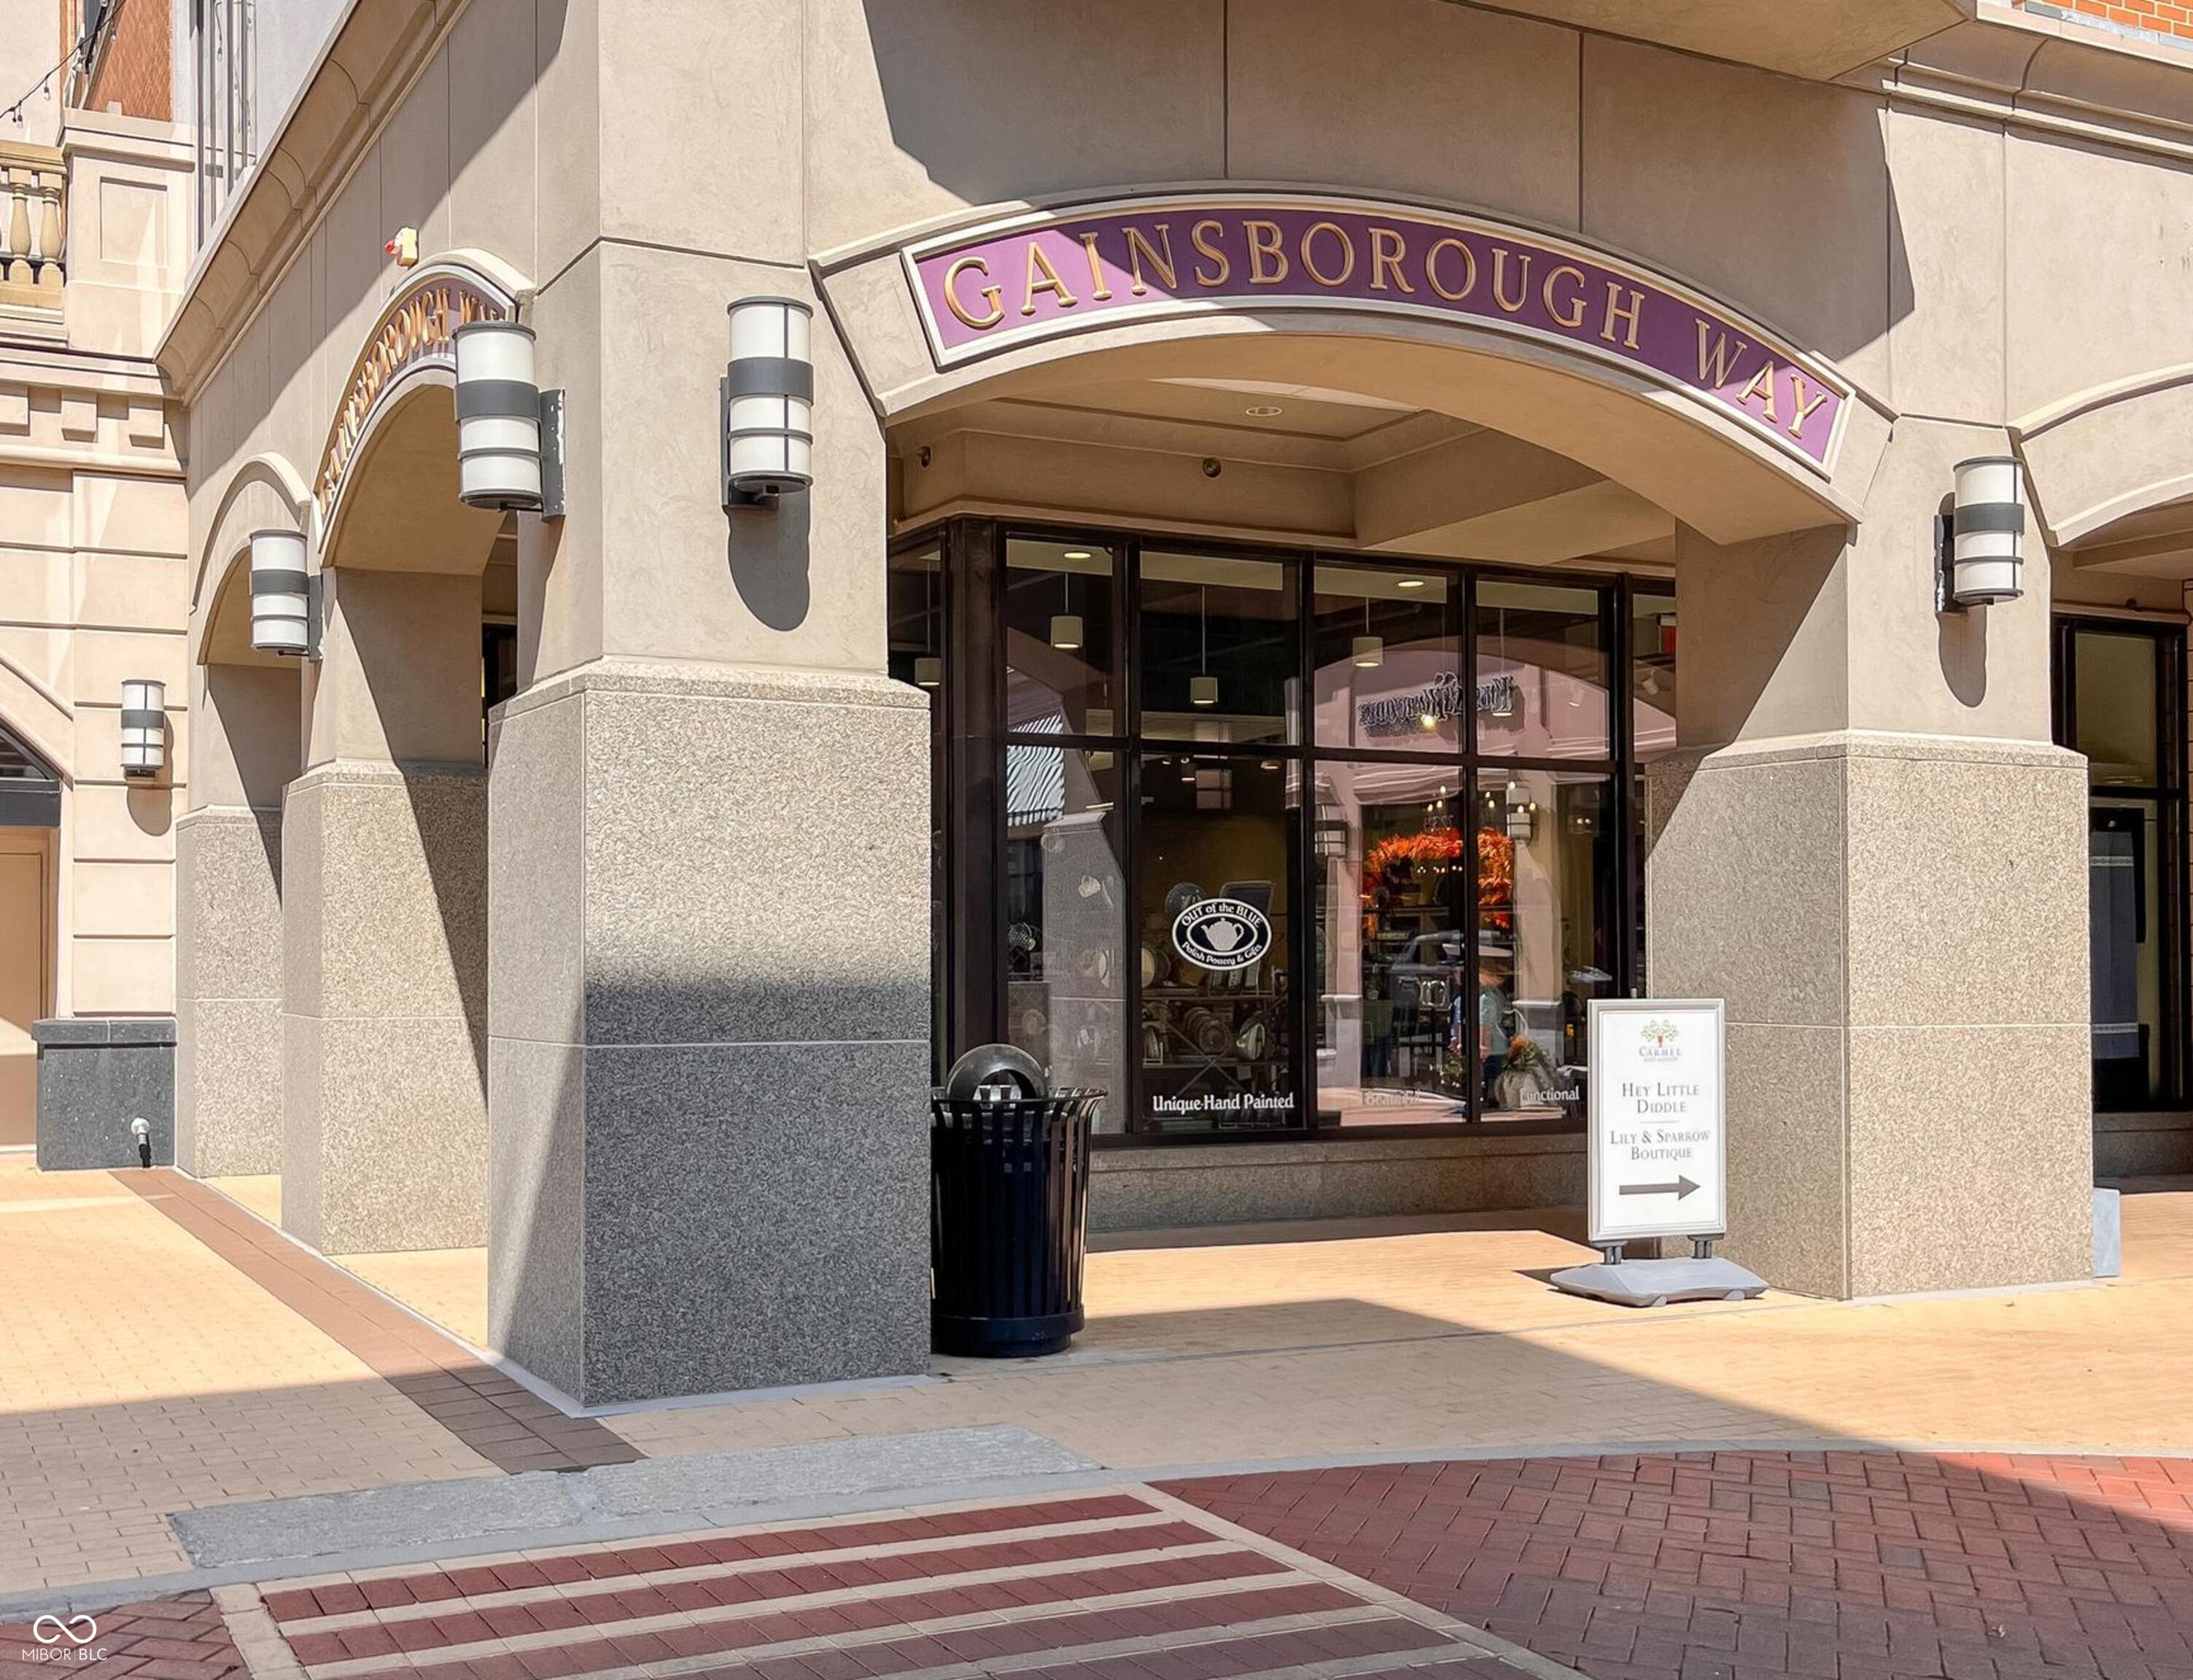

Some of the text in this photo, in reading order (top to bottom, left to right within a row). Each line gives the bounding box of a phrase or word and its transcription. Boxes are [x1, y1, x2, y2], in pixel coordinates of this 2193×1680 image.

[944, 219, 1828, 438] GAINSBOROUGH WAY
[1181, 902, 1263, 928] OUT of the BLUE
[1181, 941, 1205, 961] Polish
[1206, 954, 1235, 965] Pottery
[1244, 944, 1262, 959] Gifts
[1244, 1092, 1295, 1109] Painted
[1520, 1084, 1580, 1102] Functional
[1642, 1129, 1652, 1143] &
